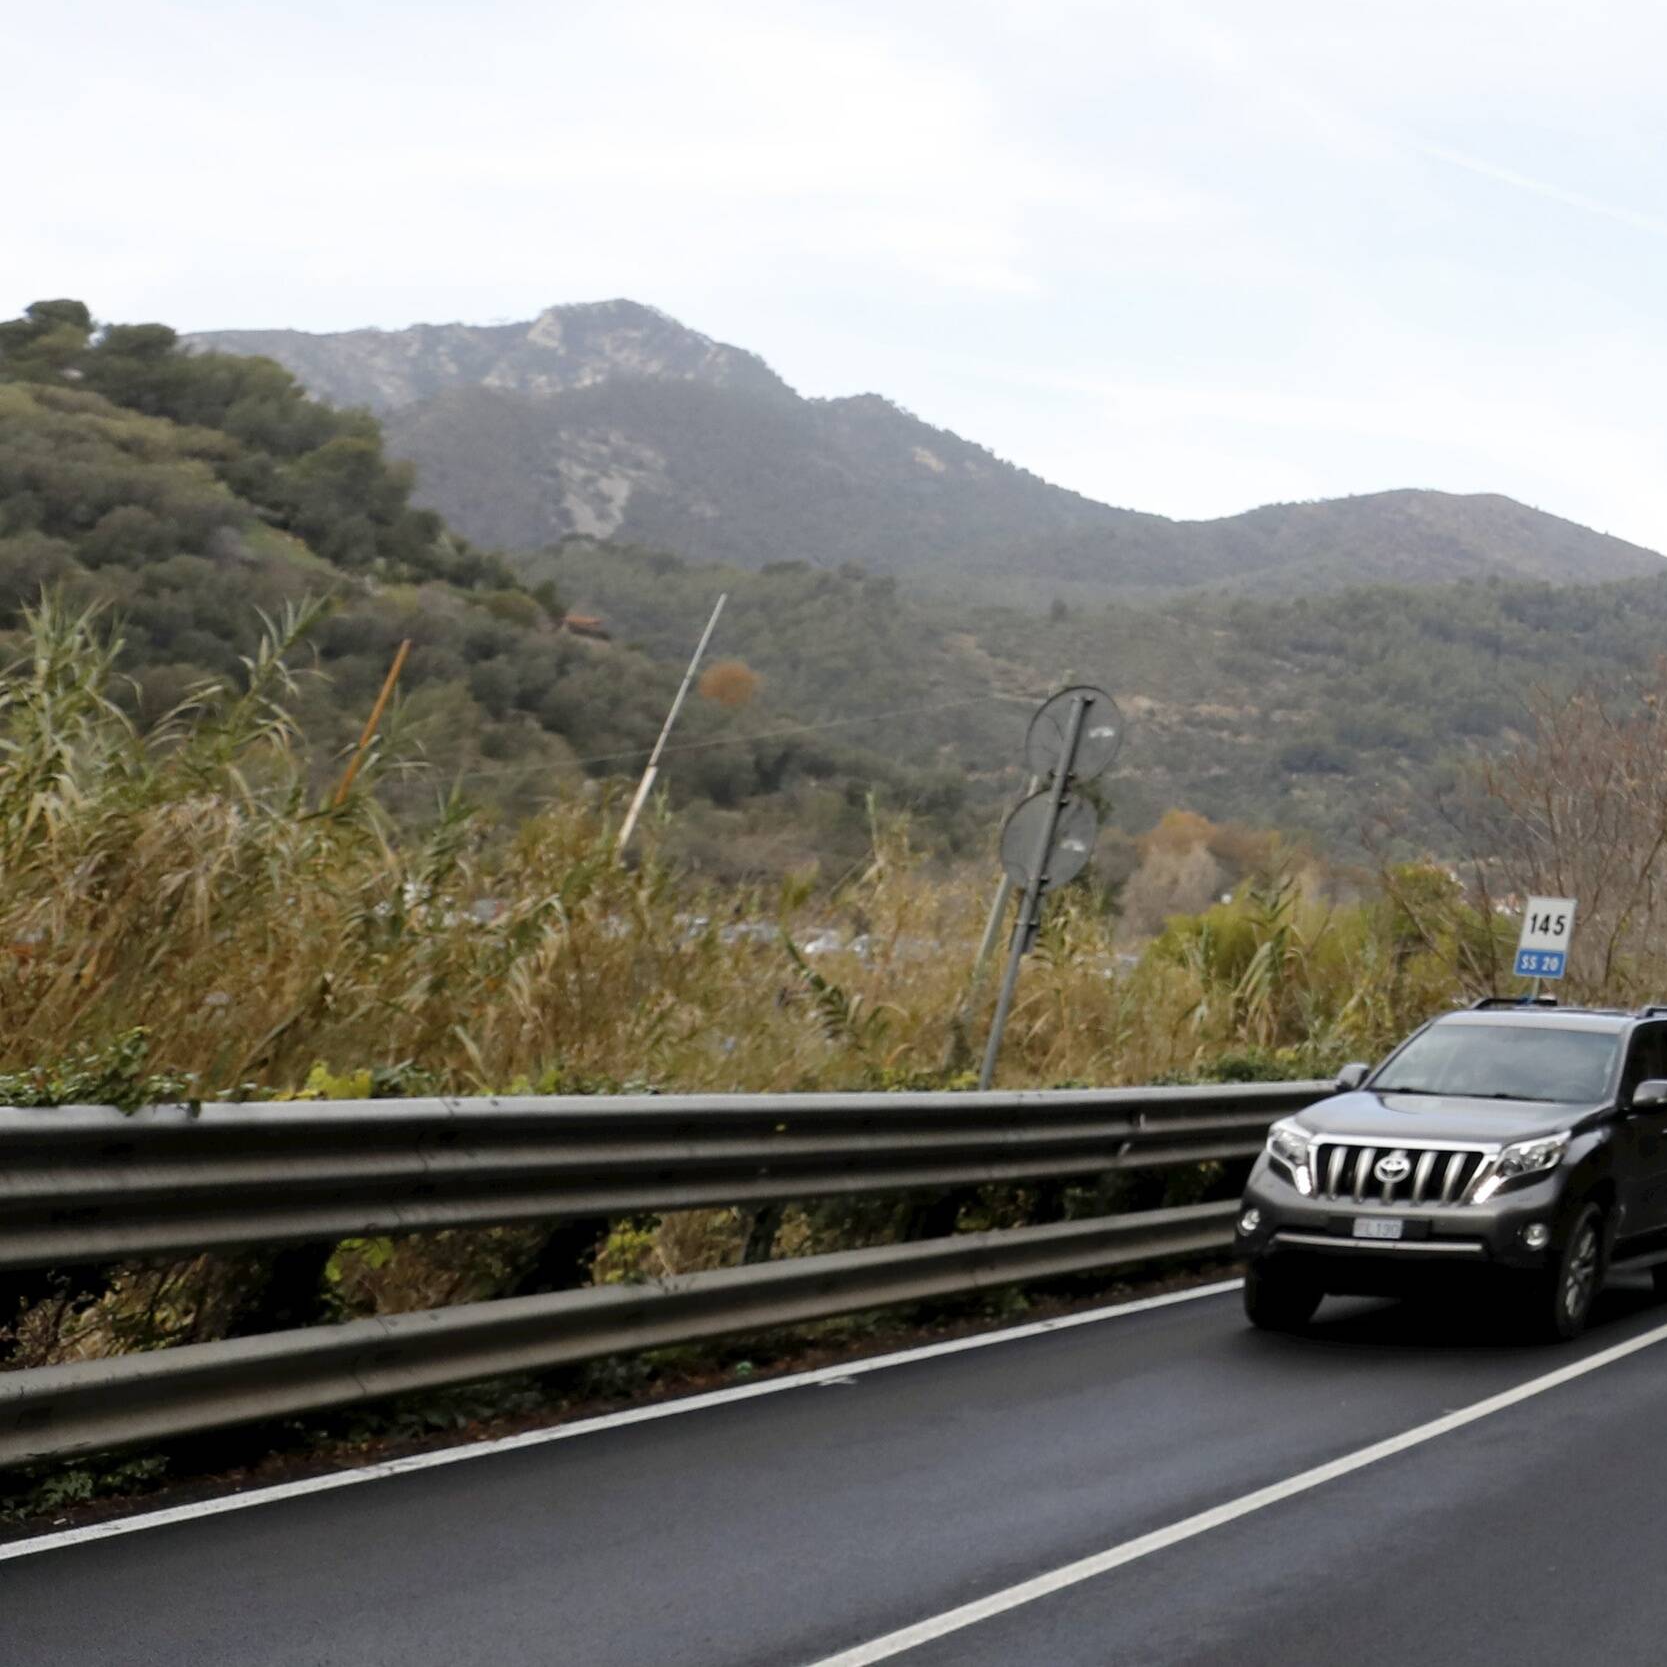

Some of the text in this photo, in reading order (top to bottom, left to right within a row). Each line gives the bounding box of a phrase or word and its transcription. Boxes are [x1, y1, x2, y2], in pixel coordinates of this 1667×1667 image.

[1530, 913, 1566, 936] 145
[1520, 955, 1560, 972] SS 20
